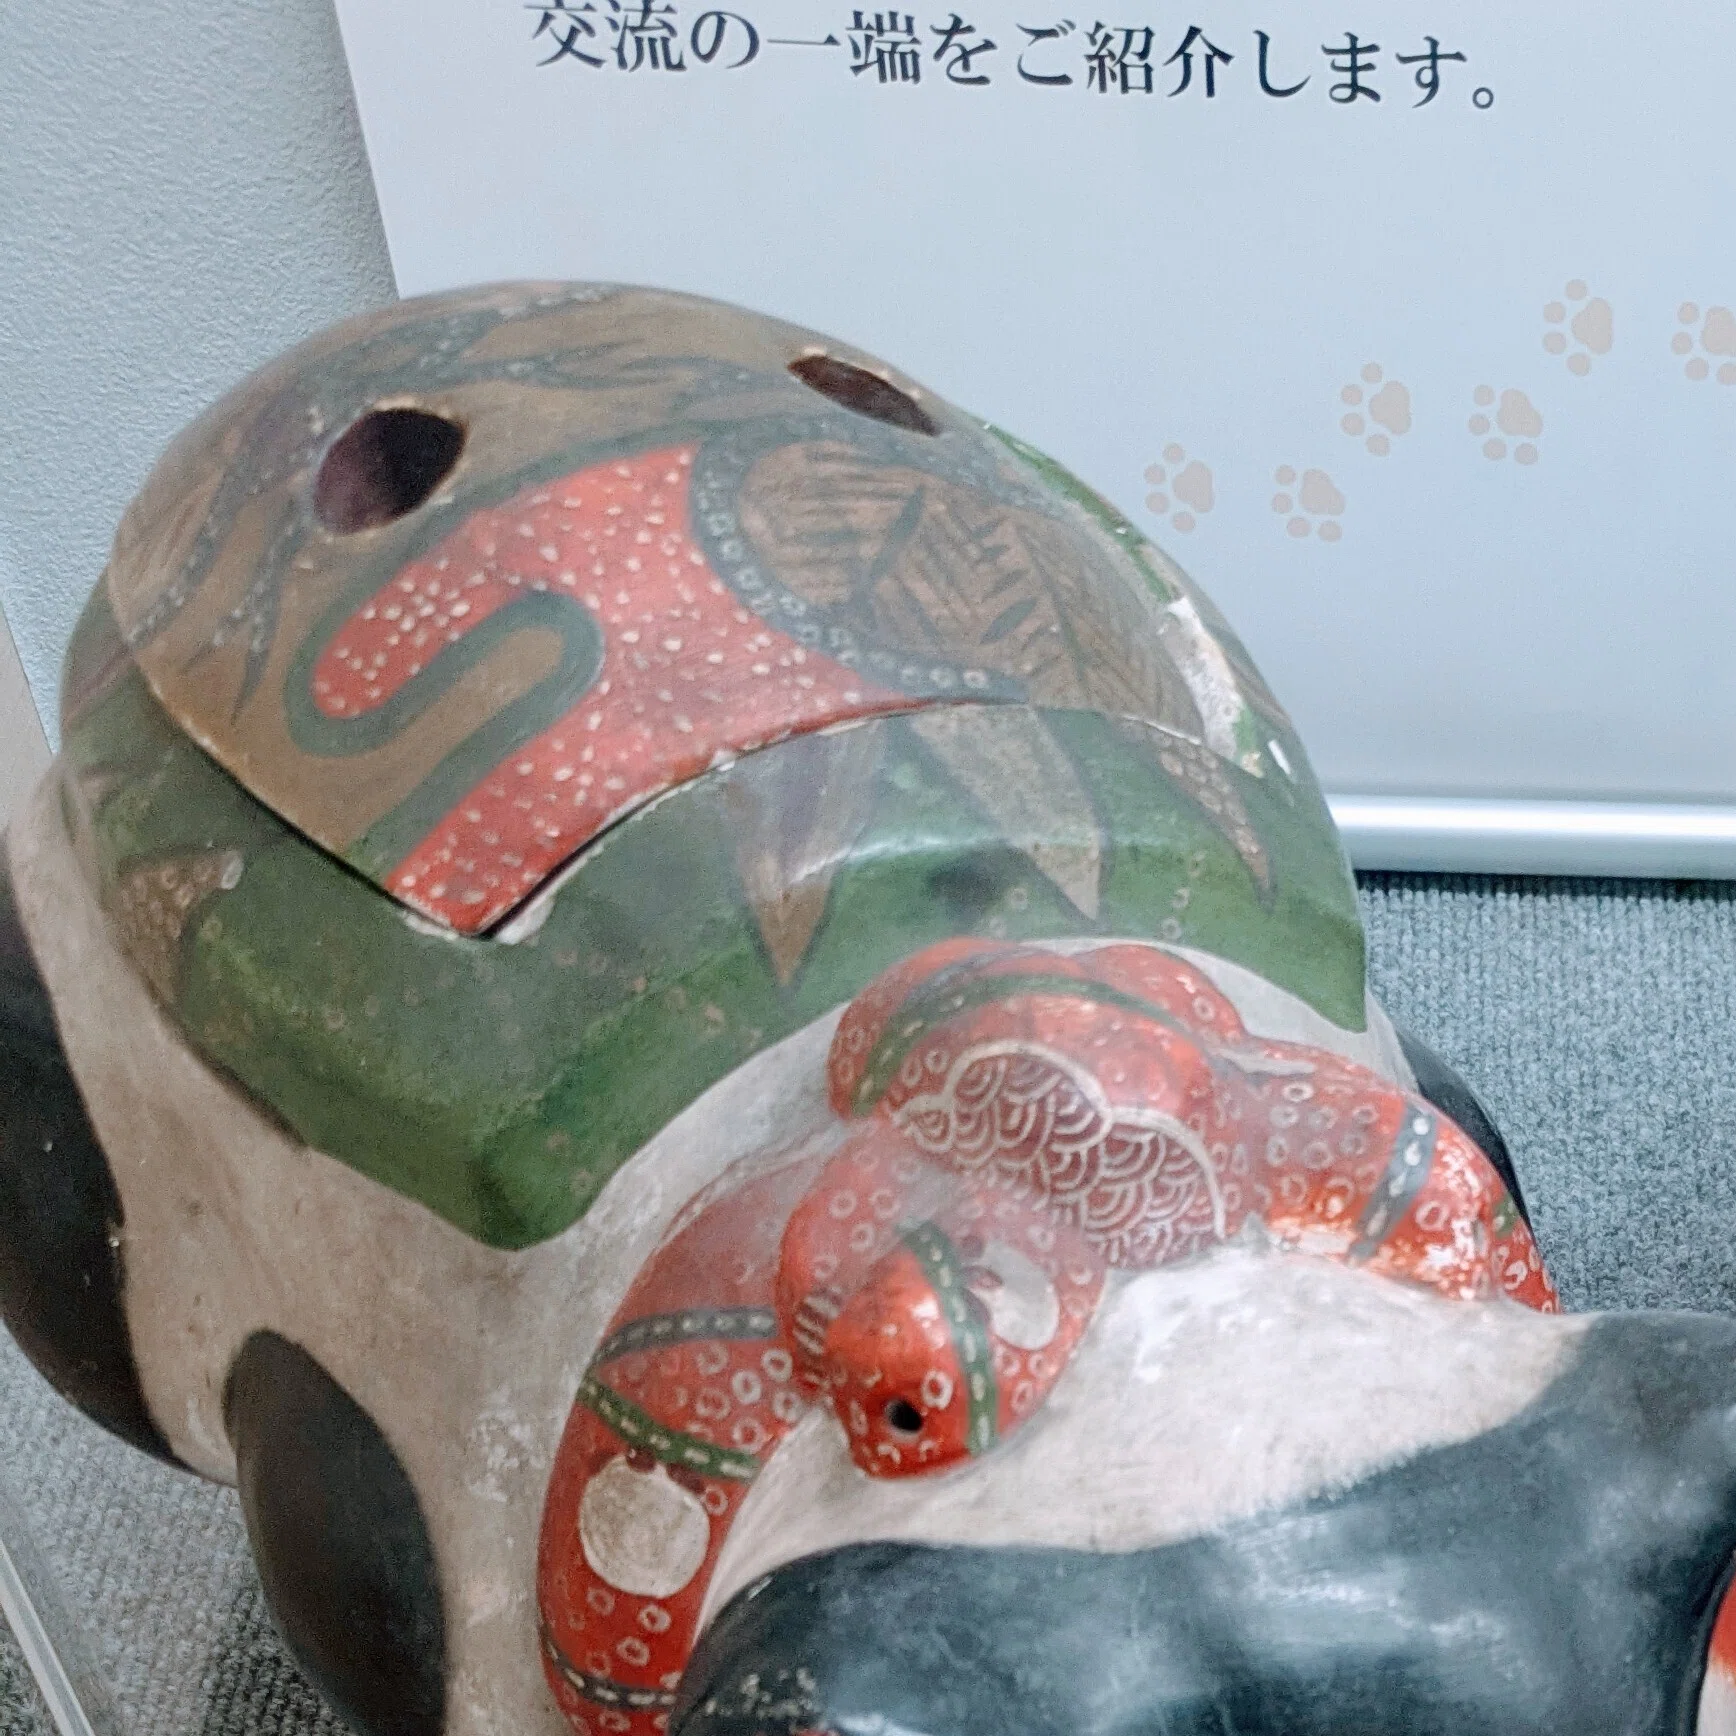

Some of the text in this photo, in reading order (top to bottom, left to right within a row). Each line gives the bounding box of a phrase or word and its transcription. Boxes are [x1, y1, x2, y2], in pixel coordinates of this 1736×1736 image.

[523, 0, 1494, 110] 交流の一端をご紹介します。
